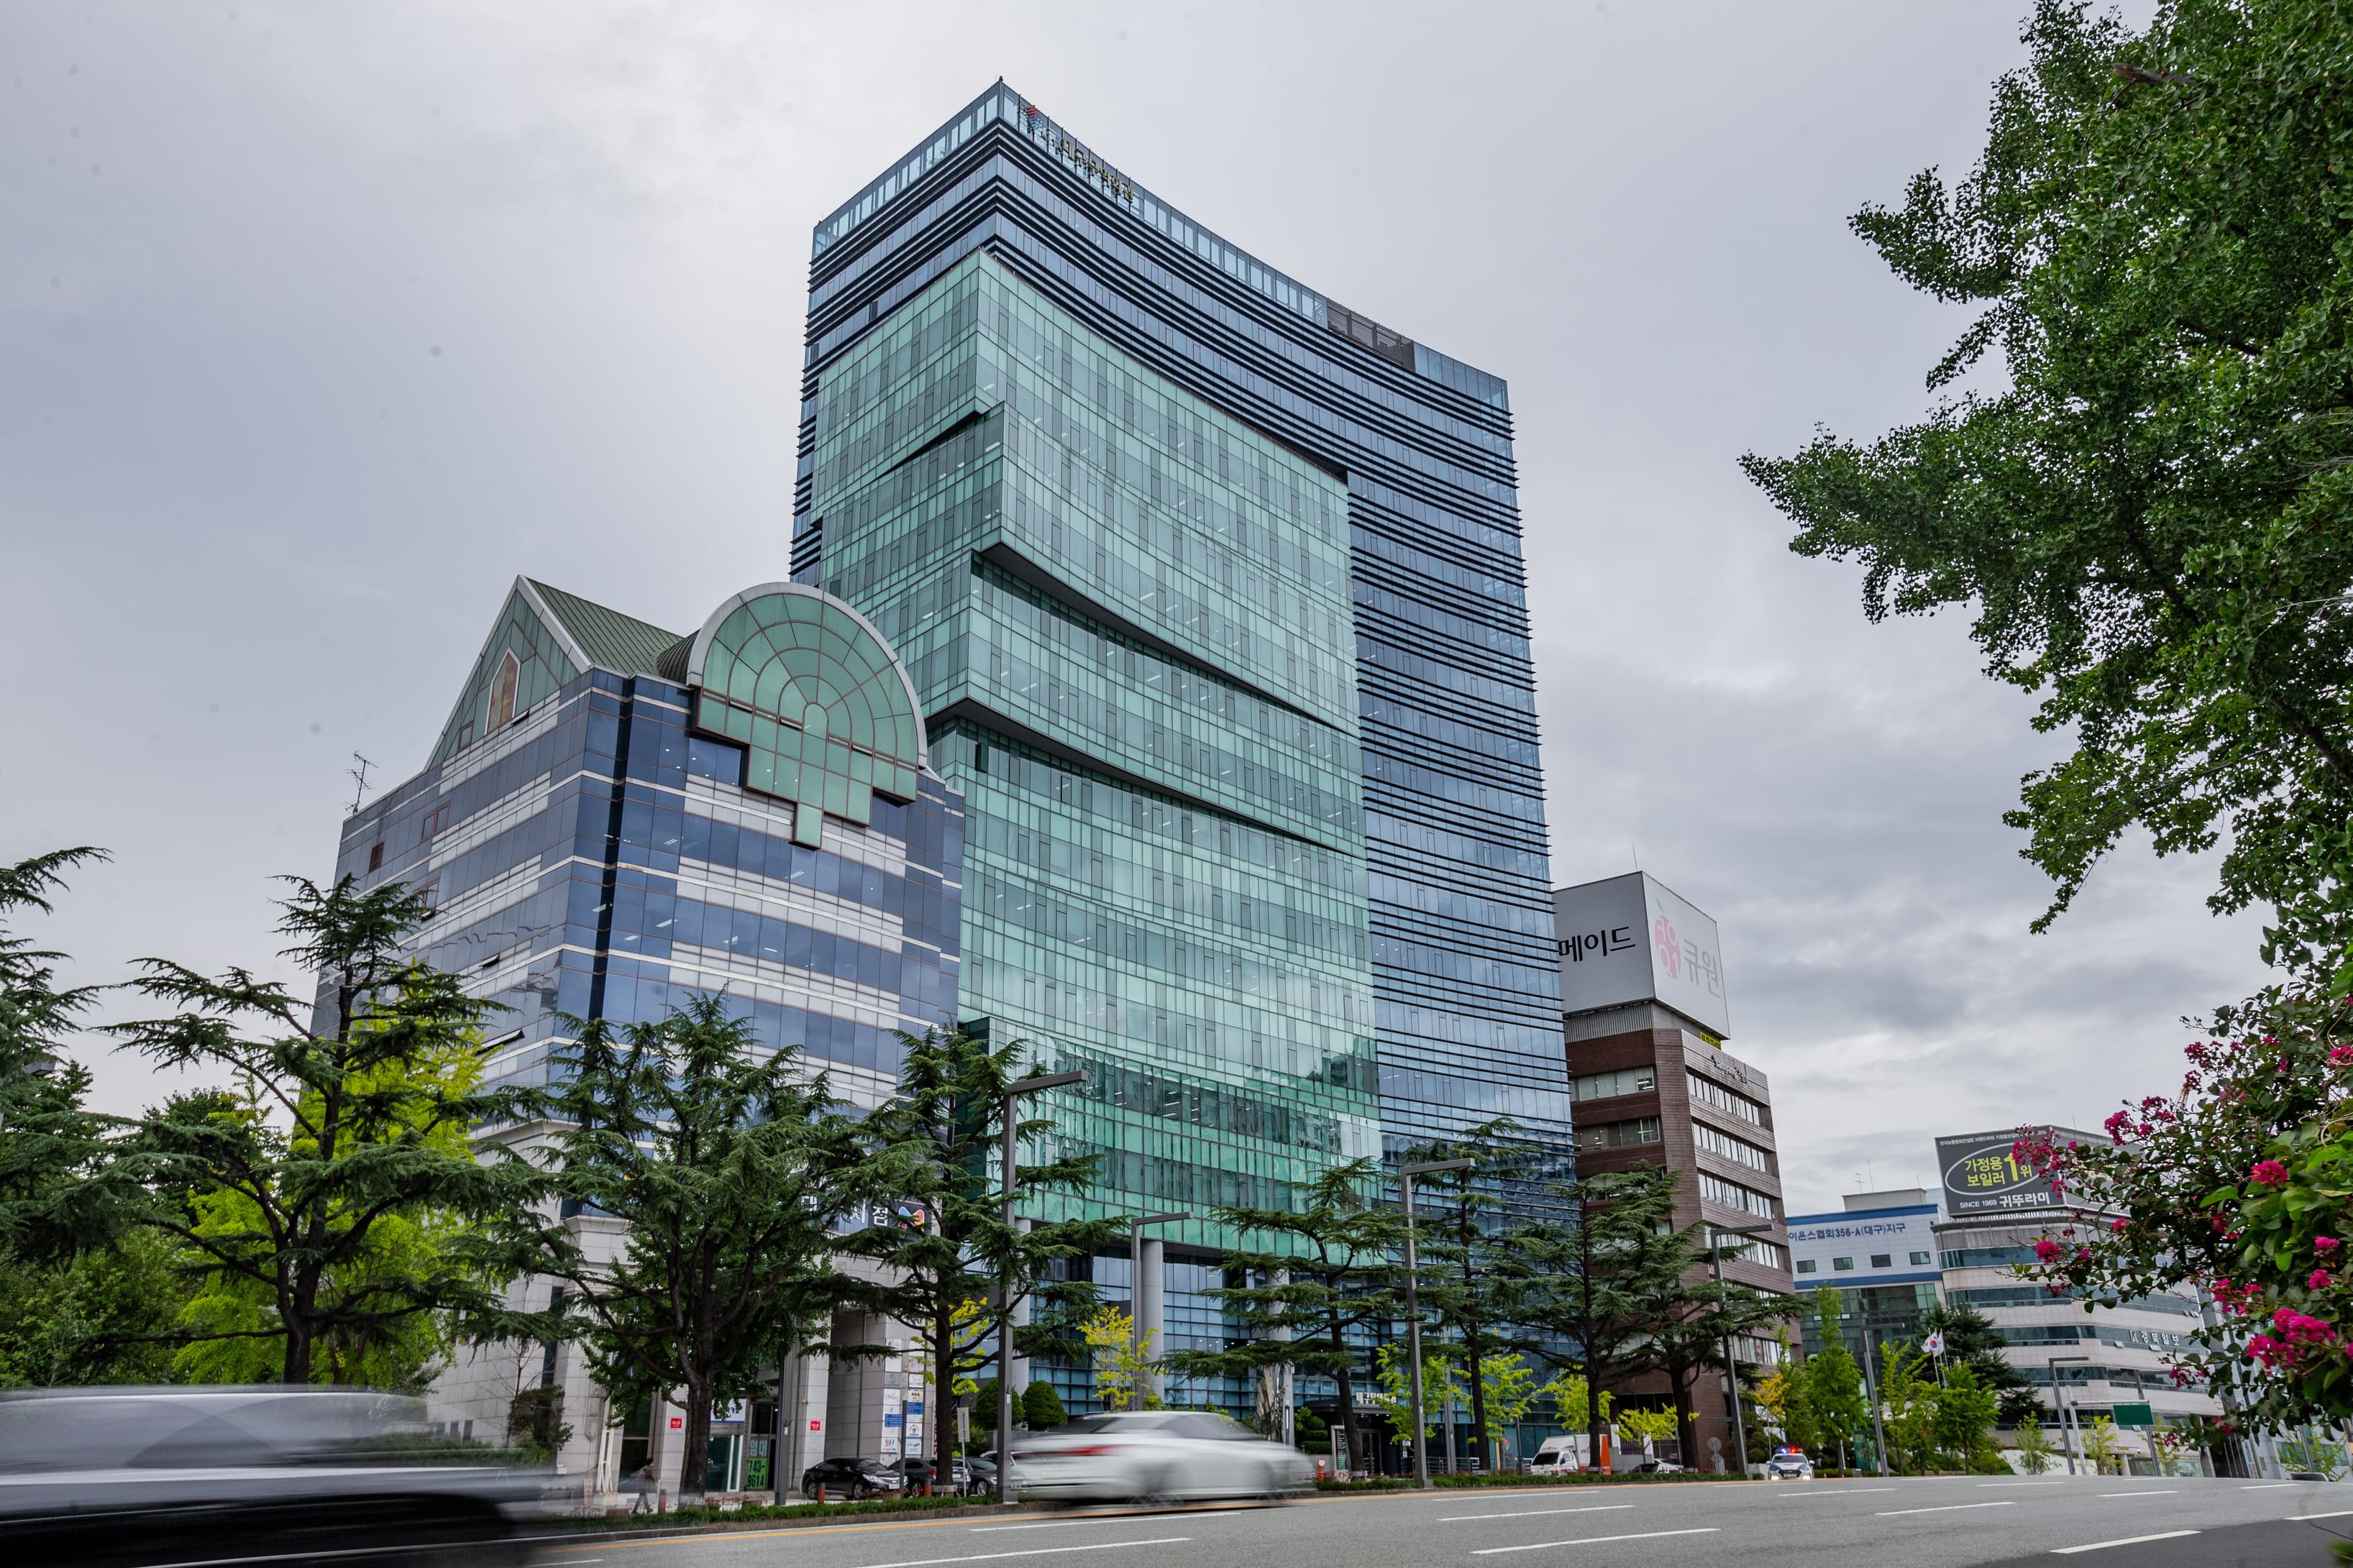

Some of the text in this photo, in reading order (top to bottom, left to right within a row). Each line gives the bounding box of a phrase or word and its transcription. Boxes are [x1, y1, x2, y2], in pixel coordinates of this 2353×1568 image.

[1558, 926, 1636, 962] 메이드
[1684, 938, 1720, 999] 큐원
[1964, 1156, 2003, 1173] 가정용
[1967, 1171, 2006, 1187] 보일러
[1999, 1191, 2050, 1209] 귀뚜라미
[2141, 1331, 2180, 1347] 경북일보
[750, 1439, 768, 1457] 임대
[749, 1460, 766, 1473] 743-
[747, 1475, 764, 1487] 9614
